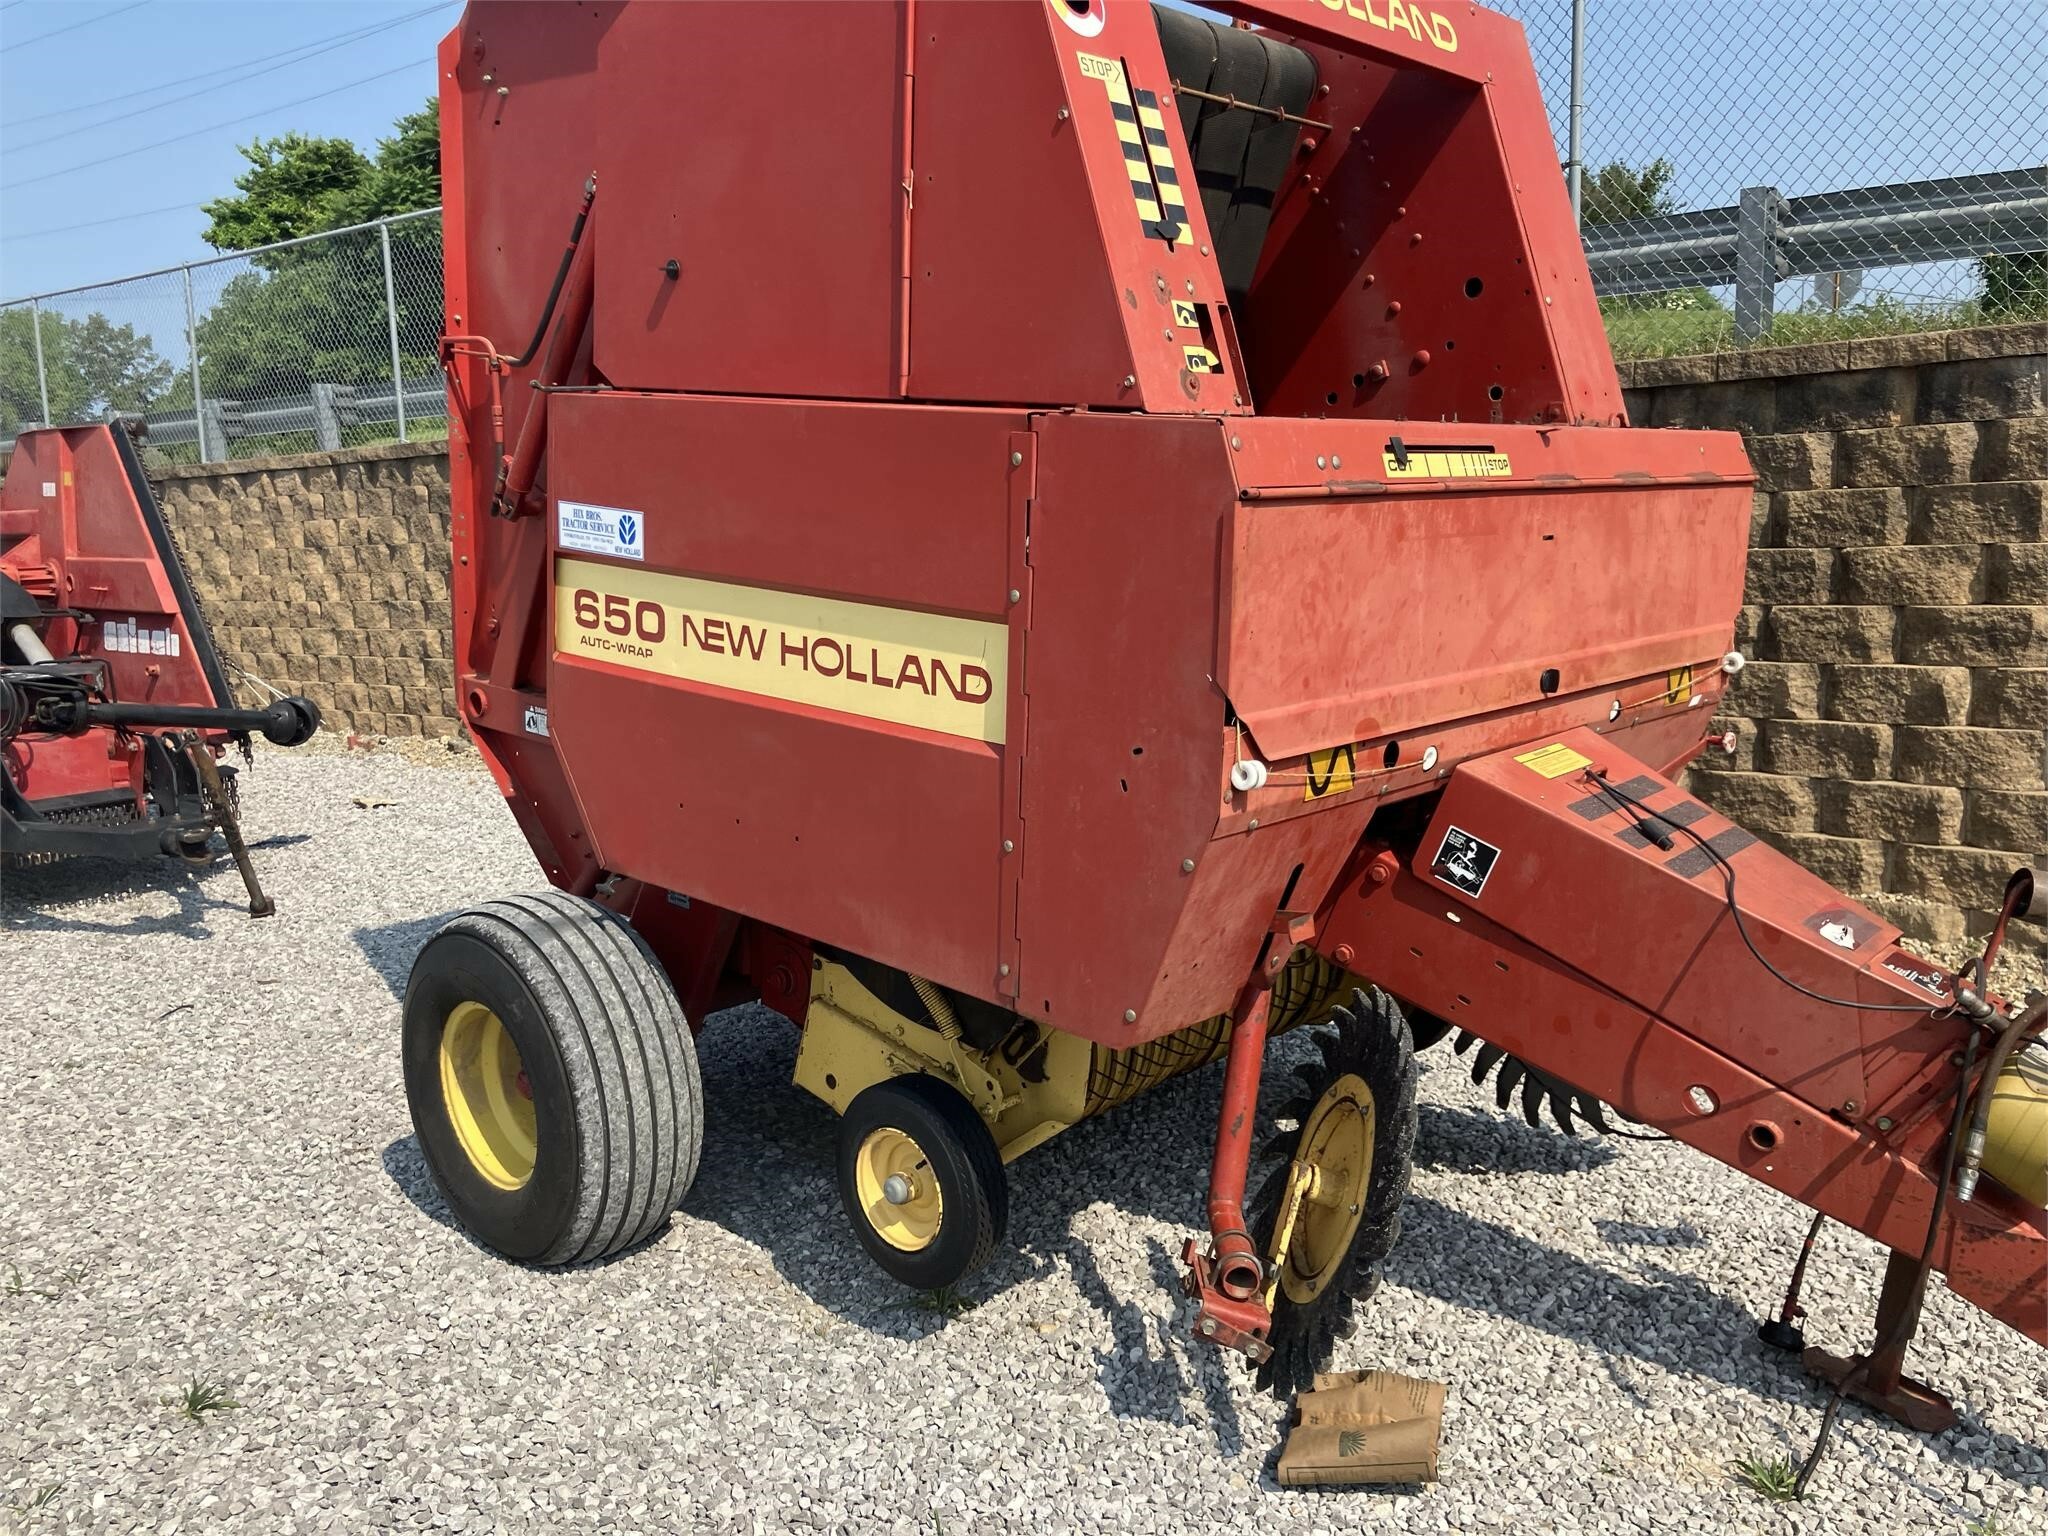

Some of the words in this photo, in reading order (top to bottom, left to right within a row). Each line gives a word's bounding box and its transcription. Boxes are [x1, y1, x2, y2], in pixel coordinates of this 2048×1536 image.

[1080, 56, 1112, 78] STOP
[1488, 459, 1508, 470] STOP
[562, 518, 587, 530] TRACTOR
[590, 521, 614, 533] SERVICE
[623, 547, 641, 557] HOLLAND
[574, 588, 666, 644] 650
[682, 614, 767, 661] NEW
[779, 631, 993, 705] HOLLAND
